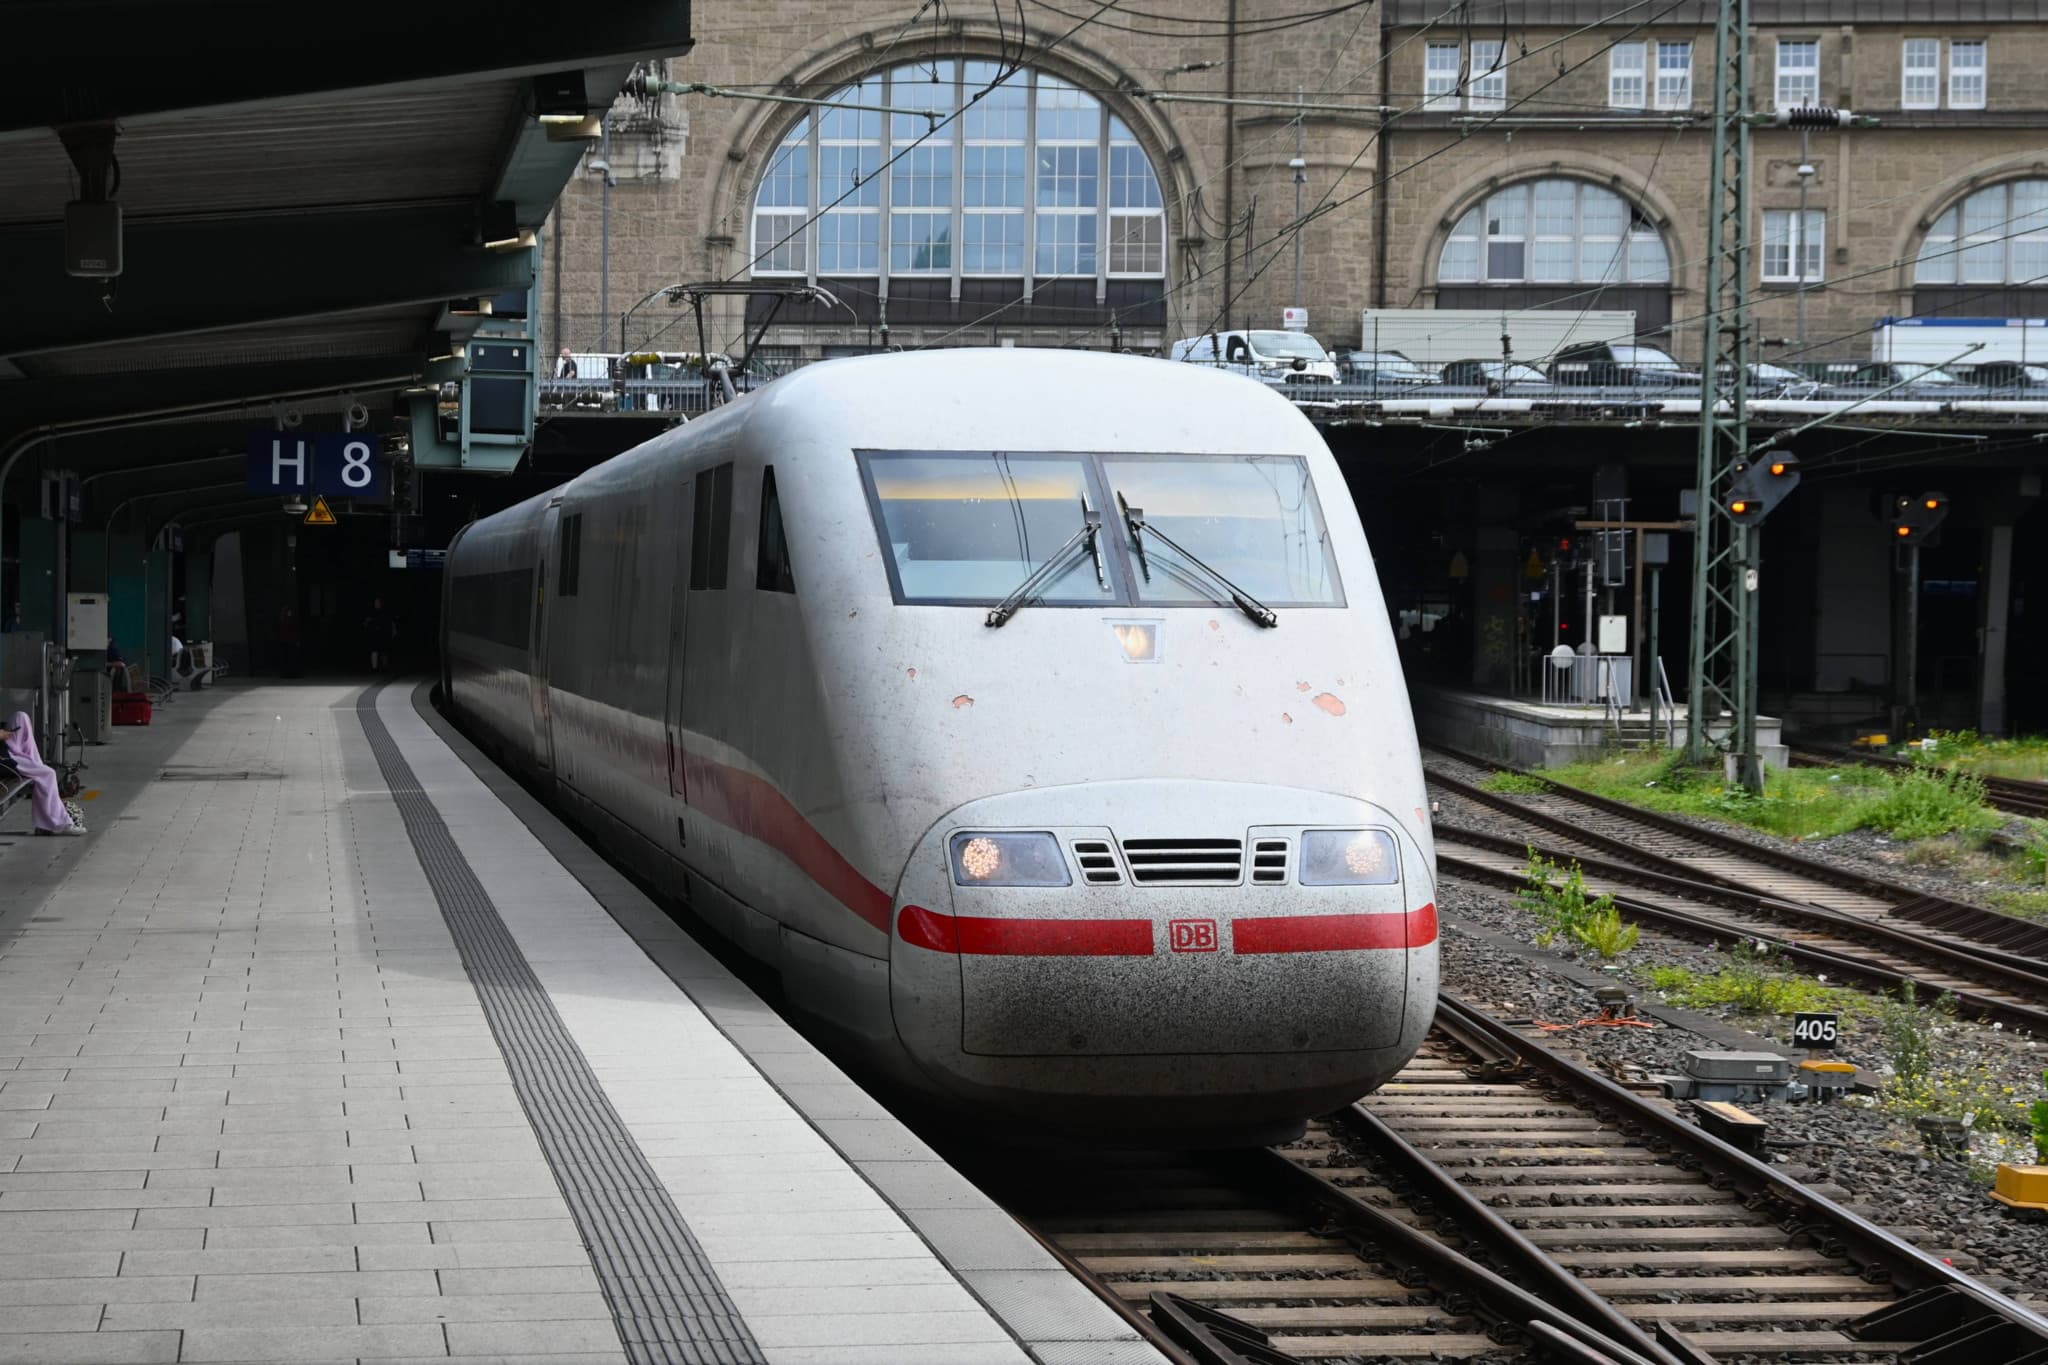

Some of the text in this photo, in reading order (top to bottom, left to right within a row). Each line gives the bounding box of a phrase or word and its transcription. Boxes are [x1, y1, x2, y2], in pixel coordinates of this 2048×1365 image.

[271, 440, 372, 488] H 8
[1175, 924, 1213, 947] DB
[1795, 1019, 1837, 1042] 405
